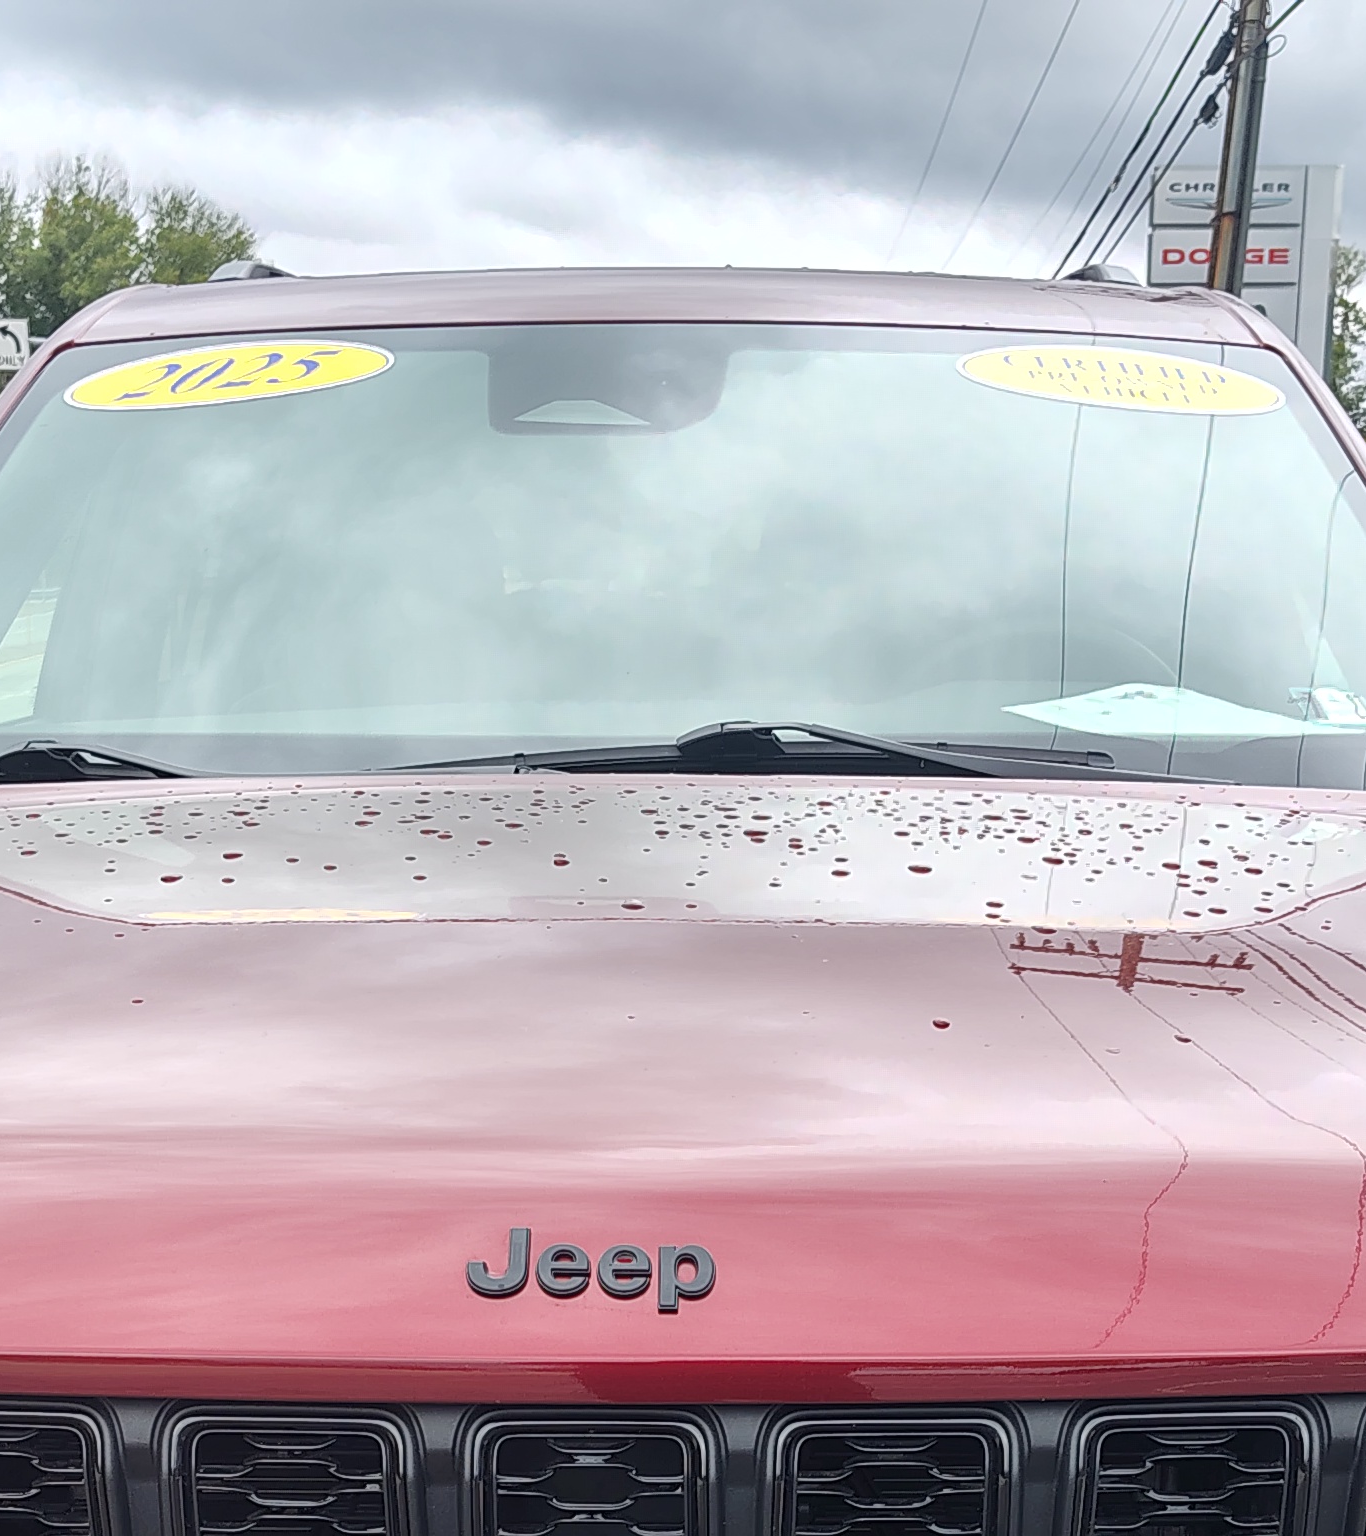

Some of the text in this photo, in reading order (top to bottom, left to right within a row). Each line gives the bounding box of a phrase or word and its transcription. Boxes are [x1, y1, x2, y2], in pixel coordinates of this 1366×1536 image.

[1168, 182, 1291, 193] CHRER
[1161, 248, 1290, 265] DOGE
[110, 349, 343, 402] 2025
[465, 1226, 717, 1314] Jeep
